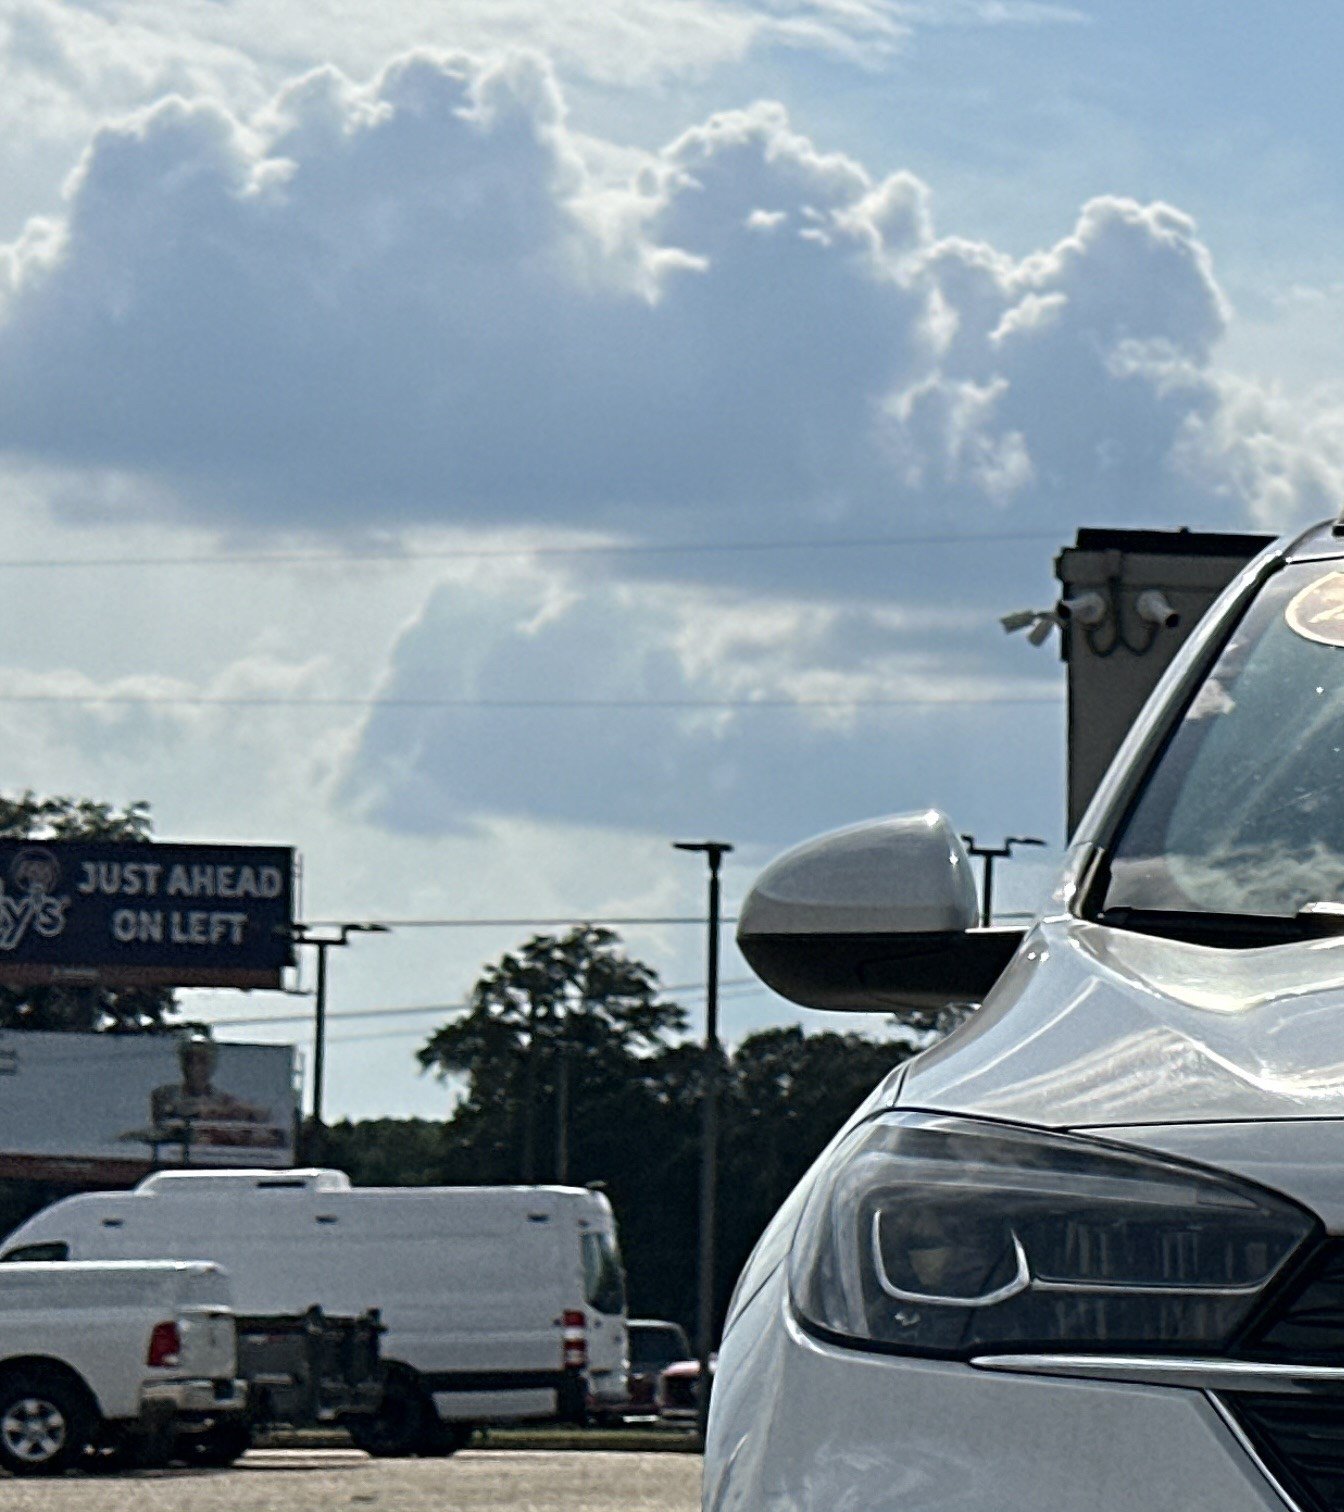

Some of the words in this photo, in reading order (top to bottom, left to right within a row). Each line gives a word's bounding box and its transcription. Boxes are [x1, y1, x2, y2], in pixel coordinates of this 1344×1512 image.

[77, 861, 163, 895] JUST
[168, 865, 284, 899] AHEAD
[112, 908, 164, 942] ON
[171, 910, 249, 945] LEFT
